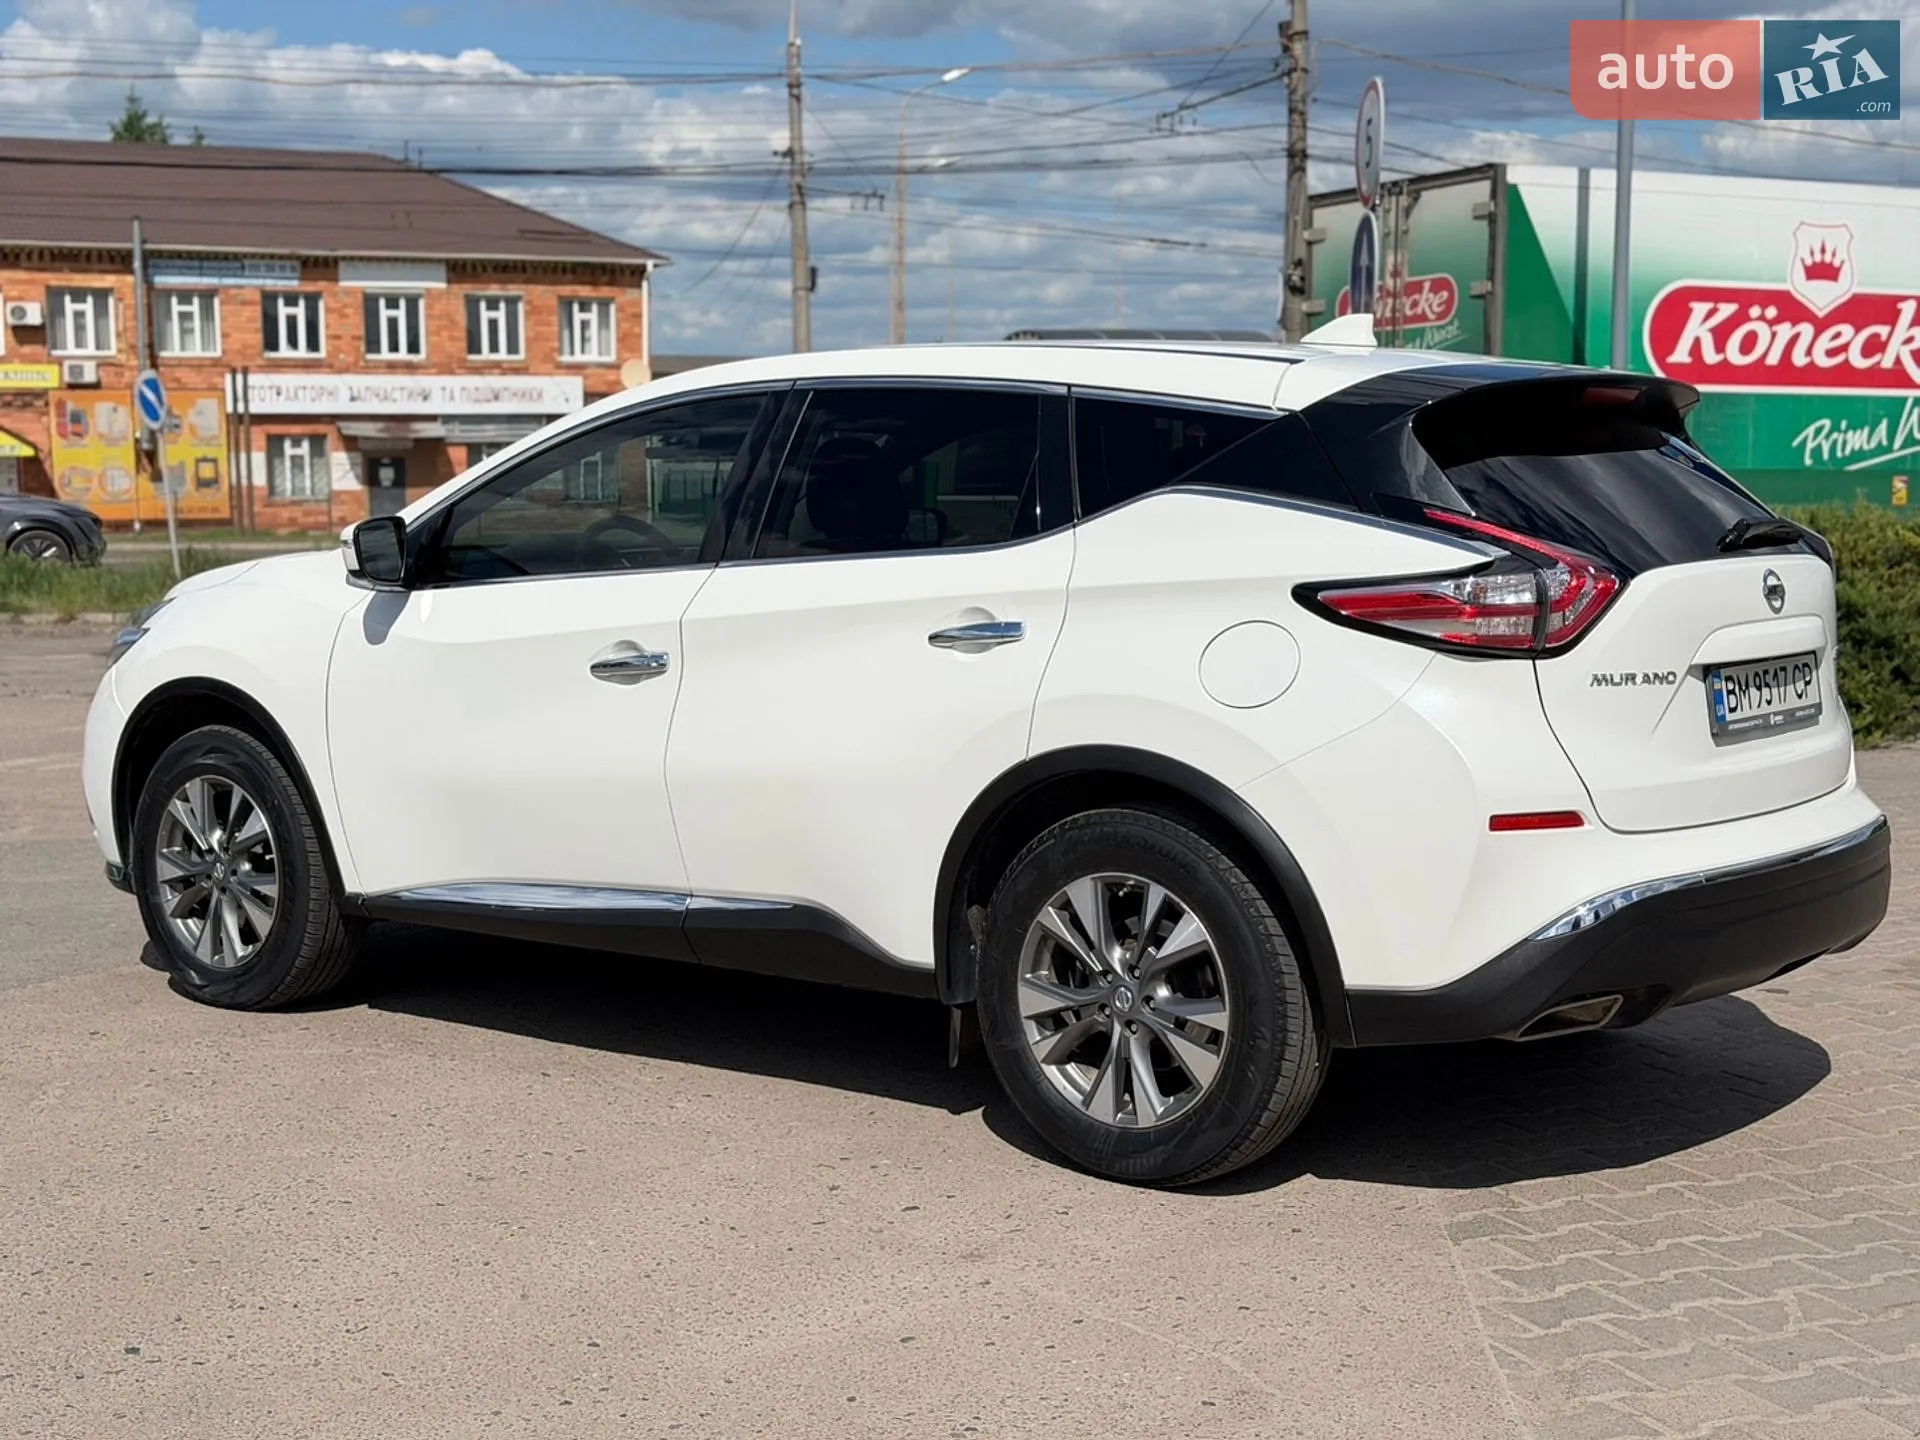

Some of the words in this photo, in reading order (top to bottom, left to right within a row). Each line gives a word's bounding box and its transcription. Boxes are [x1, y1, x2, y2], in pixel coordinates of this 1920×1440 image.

[1365, 117, 1373, 168] 5
[440, 386, 455, 403] ТА
[1792, 418, 1888, 467] Prima
[1588, 671, 1677, 687] MURANO
[1724, 672, 1752, 713] BM
[1753, 665, 1787, 708] 9517
[1793, 662, 1812, 699] CP
